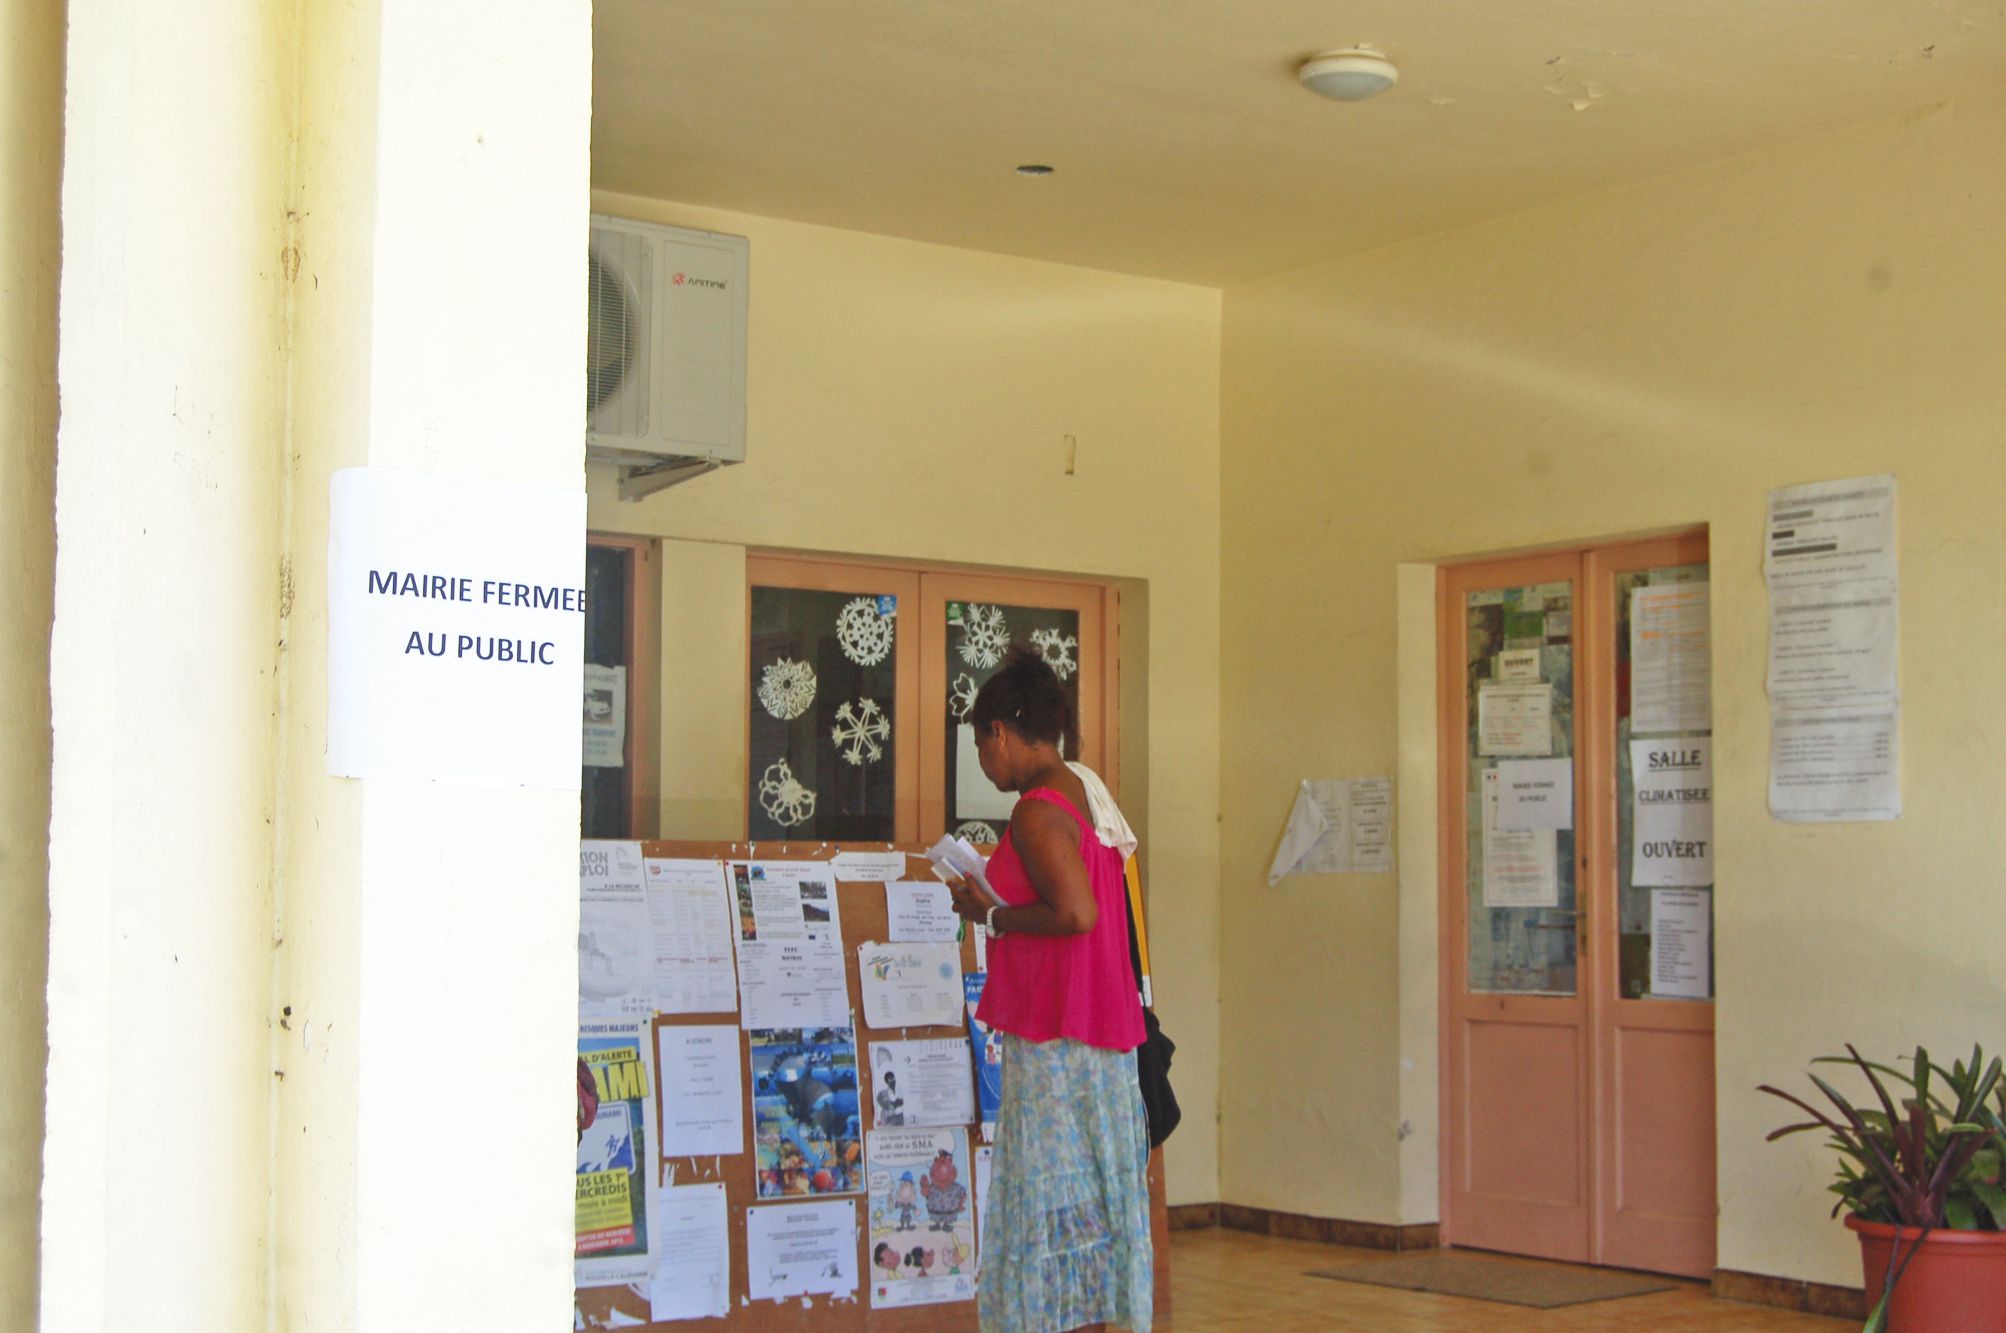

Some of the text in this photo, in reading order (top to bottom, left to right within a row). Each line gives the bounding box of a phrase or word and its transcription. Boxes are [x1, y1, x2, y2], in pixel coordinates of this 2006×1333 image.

[368, 569, 586, 613] MAIRIE FERMEE
[404, 631, 555, 665] AU PUBLIC
[1648, 749, 1701, 769] SALLE
[1642, 841, 1706, 859] OUVERT
[609, 1023, 639, 1033] MAJEURS
[592, 1048, 632, 1062] D'ALERTE
[593, 1173, 612, 1186] LES
